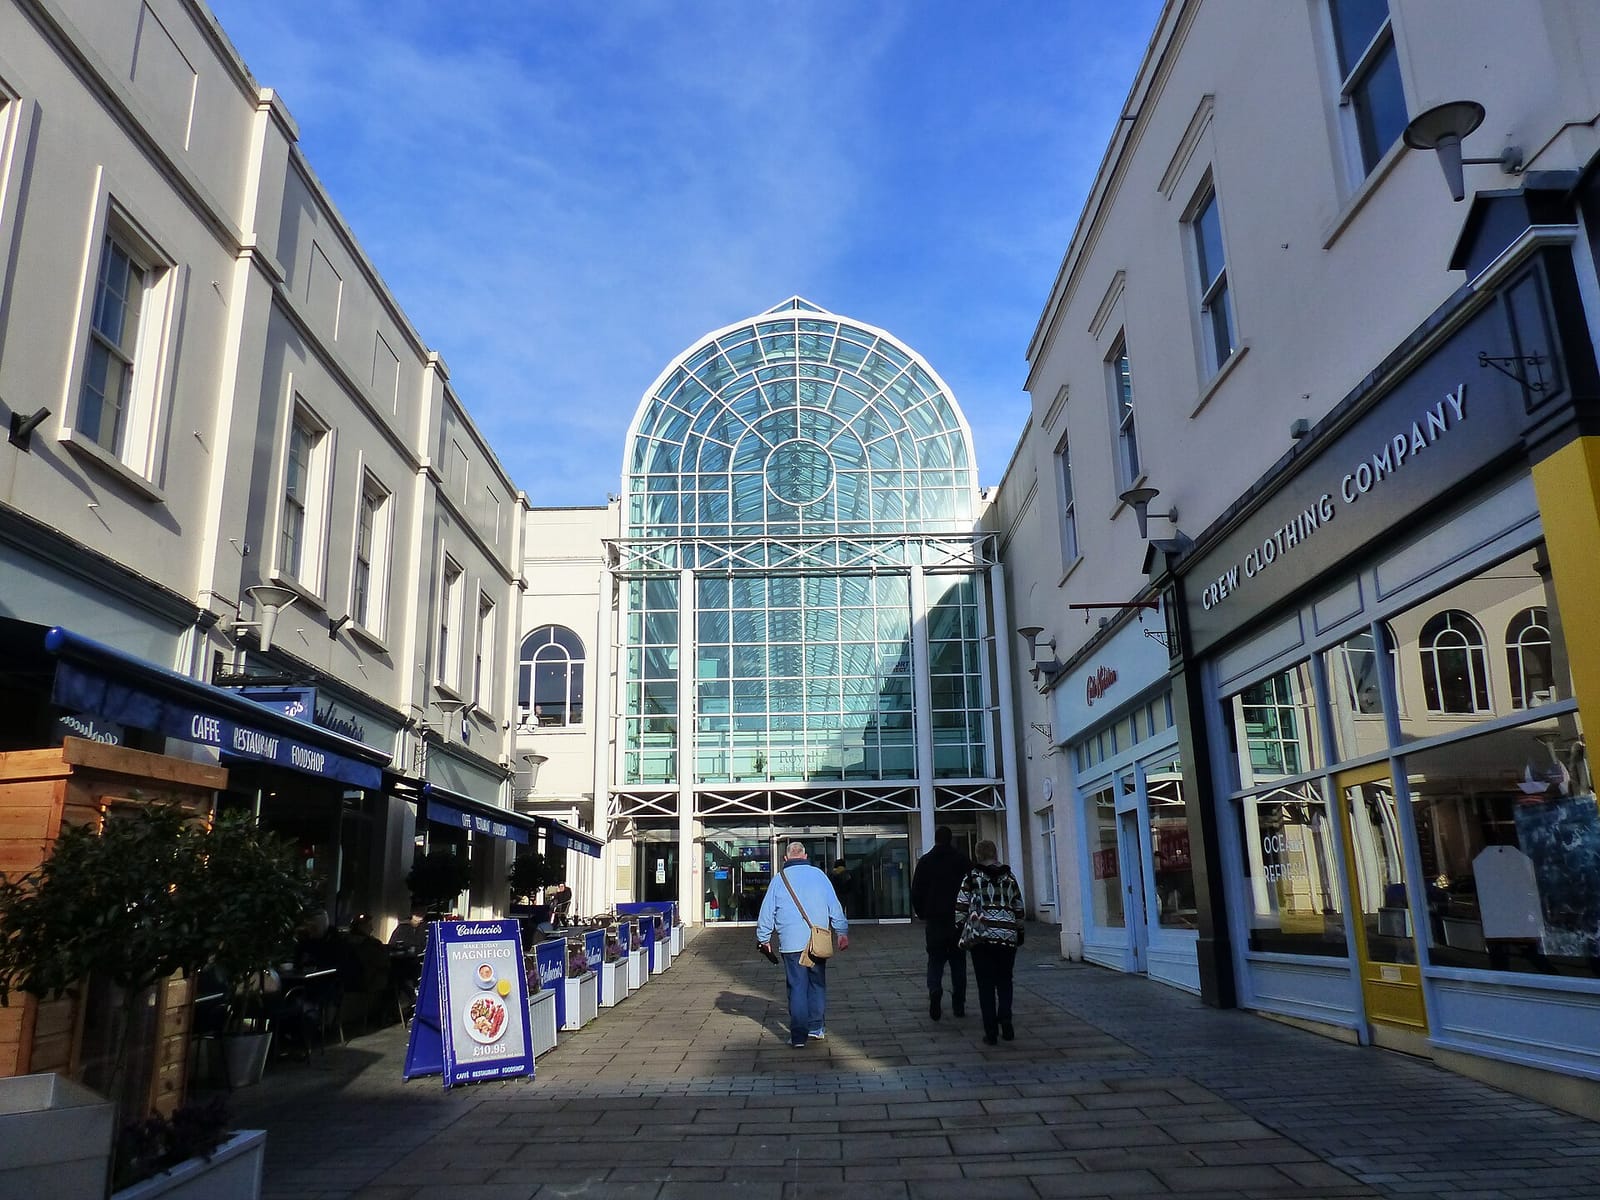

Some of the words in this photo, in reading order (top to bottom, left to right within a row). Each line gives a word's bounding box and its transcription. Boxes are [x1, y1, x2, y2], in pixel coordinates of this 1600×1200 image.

[1202, 564, 1241, 611] CREW
[1244, 494, 1335, 578] CLOTHING
[1341, 383, 1467, 504] COMPANY
[233, 727, 279, 760] RESTAURANT
[291, 745, 325, 773] FOODSHOP
[455, 923, 502, 937] Carluccio's
[452, 948, 511, 961] MAGNIFICO
[472, 1044, 506, 1056] £10.95
